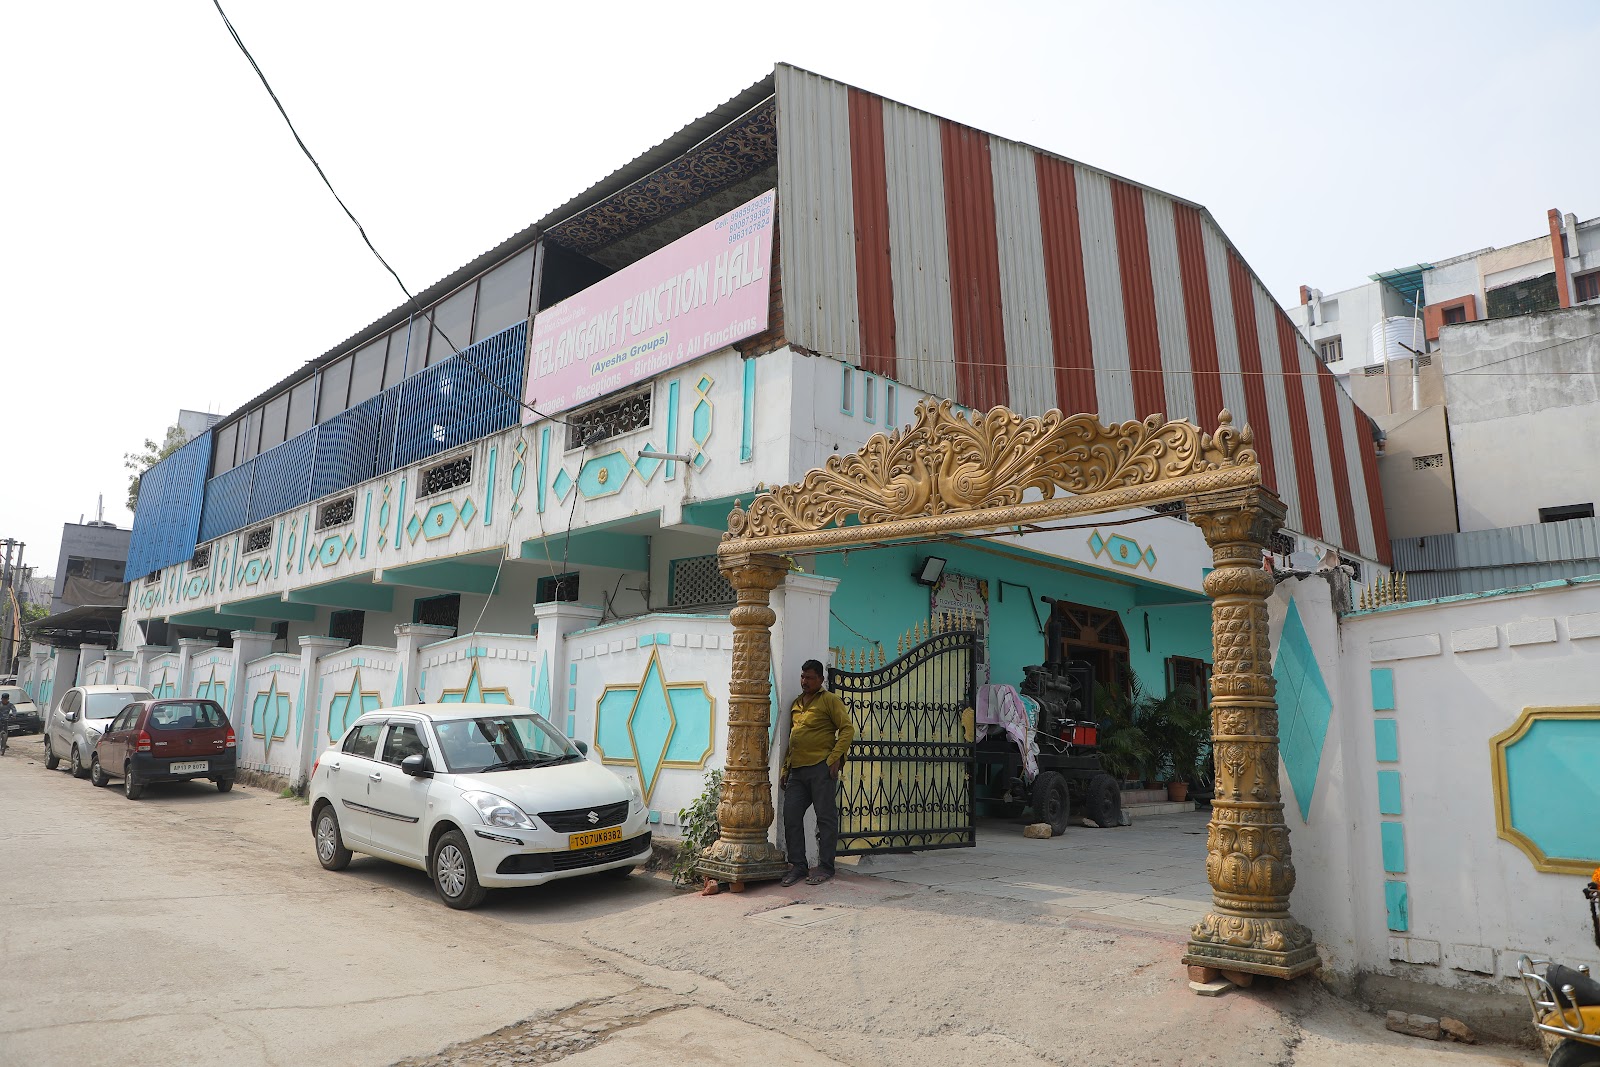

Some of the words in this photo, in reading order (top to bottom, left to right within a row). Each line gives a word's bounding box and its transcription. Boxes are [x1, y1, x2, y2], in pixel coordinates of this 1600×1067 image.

[533, 305, 619, 381] TELANGANA
[620, 262, 710, 343] FUNCTION
[712, 235, 765, 306] HALL
[575, 373, 622, 401] Receptions
[633, 350, 674, 378] Birthday
[676, 342, 684, 361] &
[687, 335, 701, 357] All
[703, 316, 757, 349] Functions
[591, 352, 628, 376] (Ayesha
[630, 332, 669, 357] Groups)
[574, 829, 622, 847] TS07UK8382
